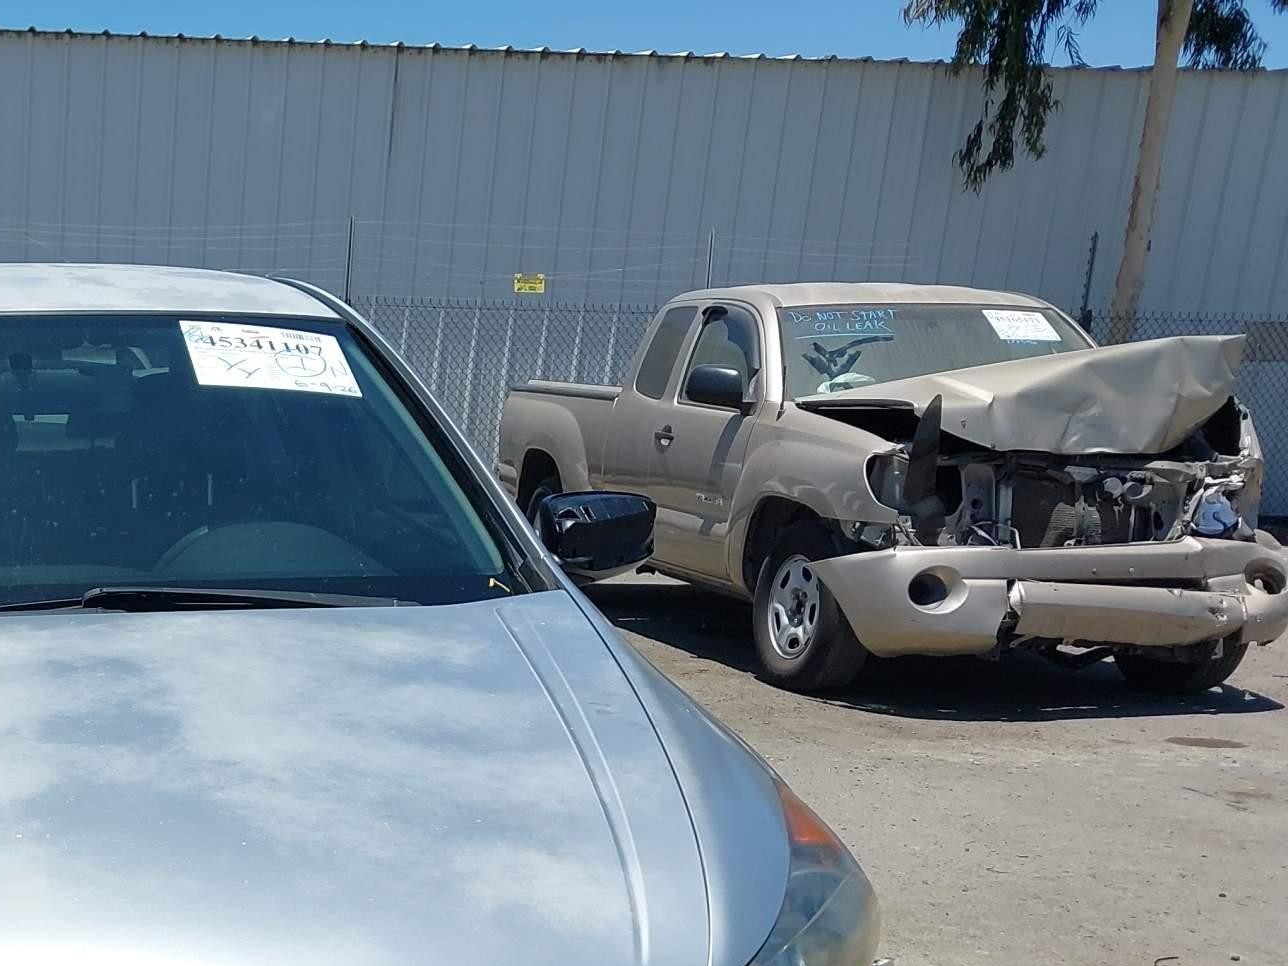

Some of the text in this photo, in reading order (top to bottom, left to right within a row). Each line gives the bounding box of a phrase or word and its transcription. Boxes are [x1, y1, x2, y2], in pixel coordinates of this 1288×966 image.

[816, 311, 849, 321] NOT
[850, 309, 897, 321] START
[814, 320, 893, 332] OIL LEAK
[202, 335, 323, 357] 45341107
